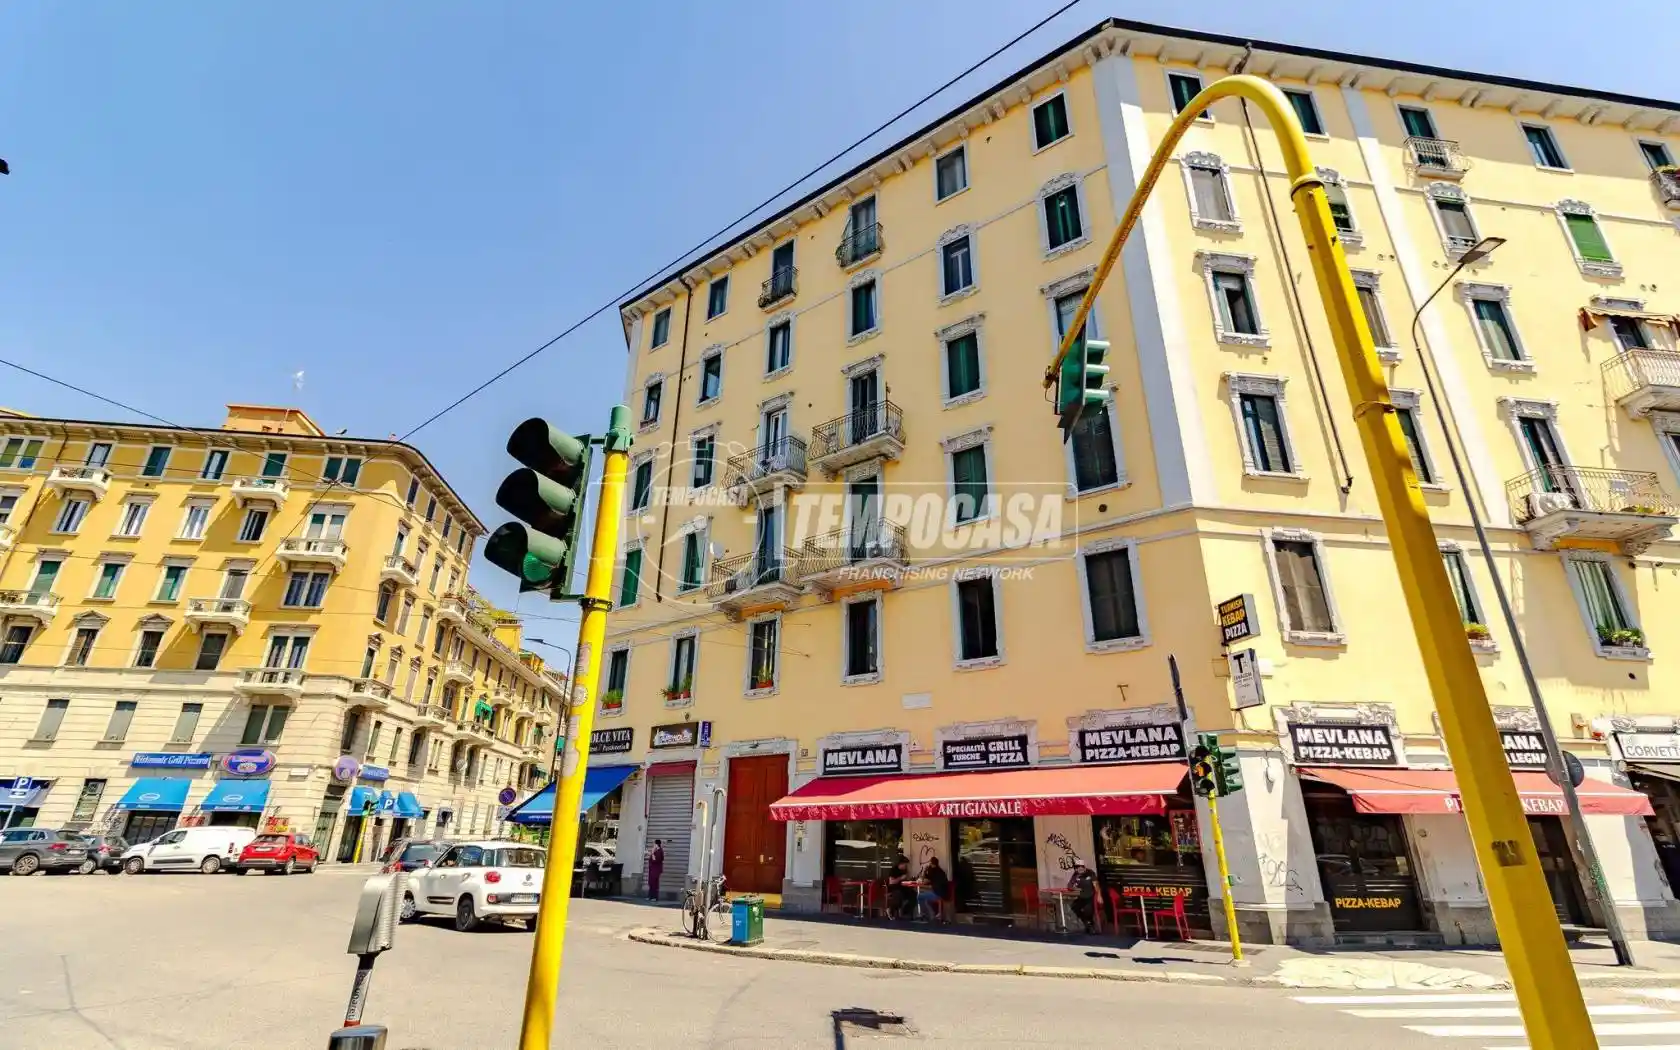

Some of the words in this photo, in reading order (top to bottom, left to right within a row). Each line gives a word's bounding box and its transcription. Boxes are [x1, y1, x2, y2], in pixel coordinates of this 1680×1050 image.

[1222, 609, 1245, 625] KEBAP
[1225, 623, 1247, 640] PIZZA
[591, 730, 611, 743] OLCE
[613, 729, 631, 741] VITA
[1085, 726, 1178, 746] MEVLANA
[1296, 728, 1388, 745] MEVLANA
[988, 740, 1021, 752] GRILL
[1085, 743, 1180, 760] PIZZA-KEBAP
[1299, 746, 1391, 760] PIZZA-KEBAP
[826, 749, 898, 766] MEVLANA
[952, 753, 981, 761] TURCHE
[988, 752, 1025, 764] PIZZA
[937, 800, 1021, 816] ARTIGIANALE
[1335, 897, 1401, 908] PIZZA-KEBAP
